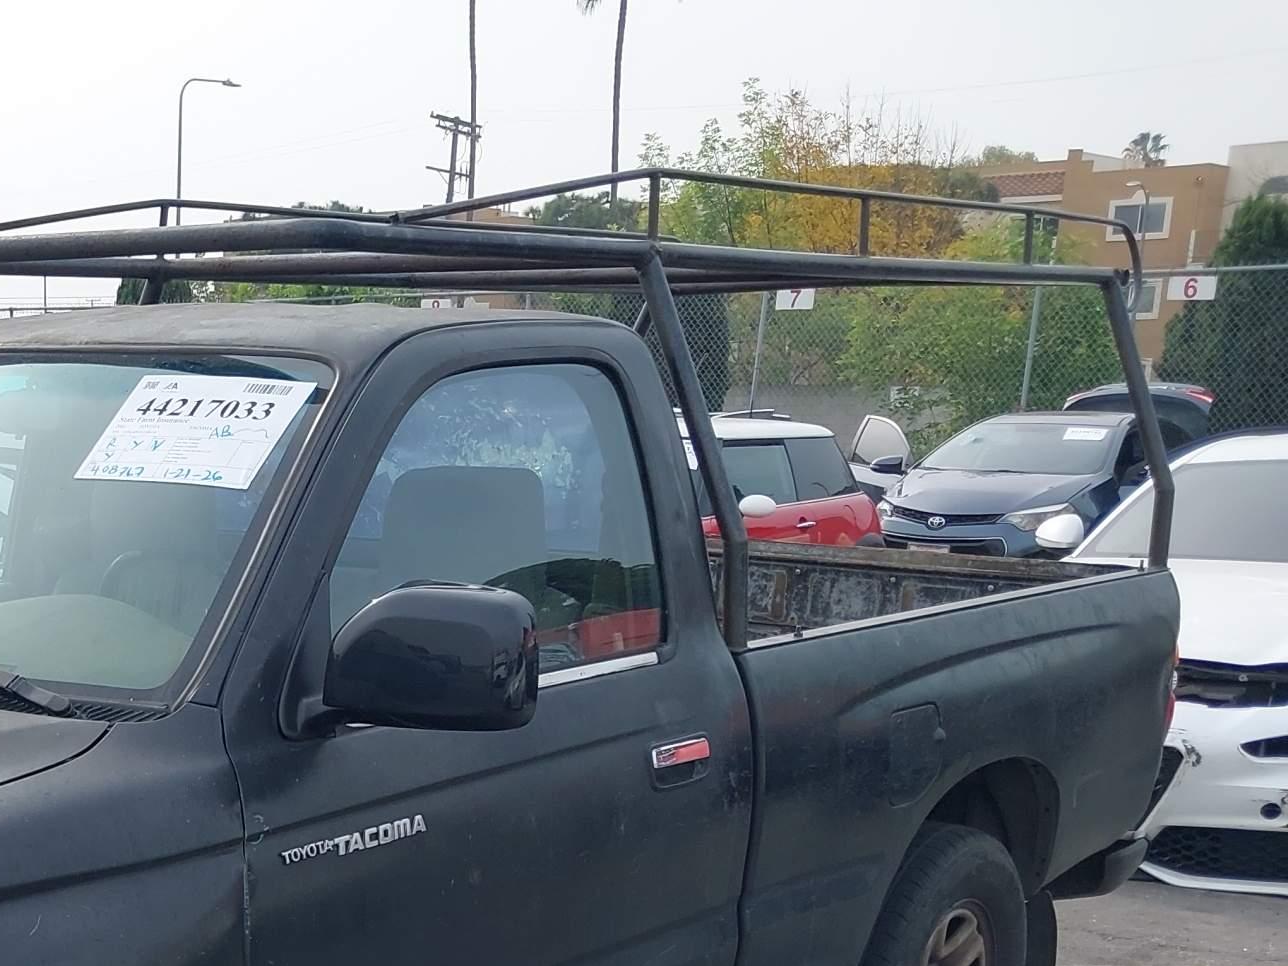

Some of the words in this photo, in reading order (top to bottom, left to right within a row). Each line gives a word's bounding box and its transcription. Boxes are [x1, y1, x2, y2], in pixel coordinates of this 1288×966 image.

[790, 289, 801, 308] 7
[1183, 277, 1198, 299] 6
[136, 397, 276, 420] 44217033
[281, 840, 333, 864] TOYOTA
[334, 814, 427, 856] TACOMA
